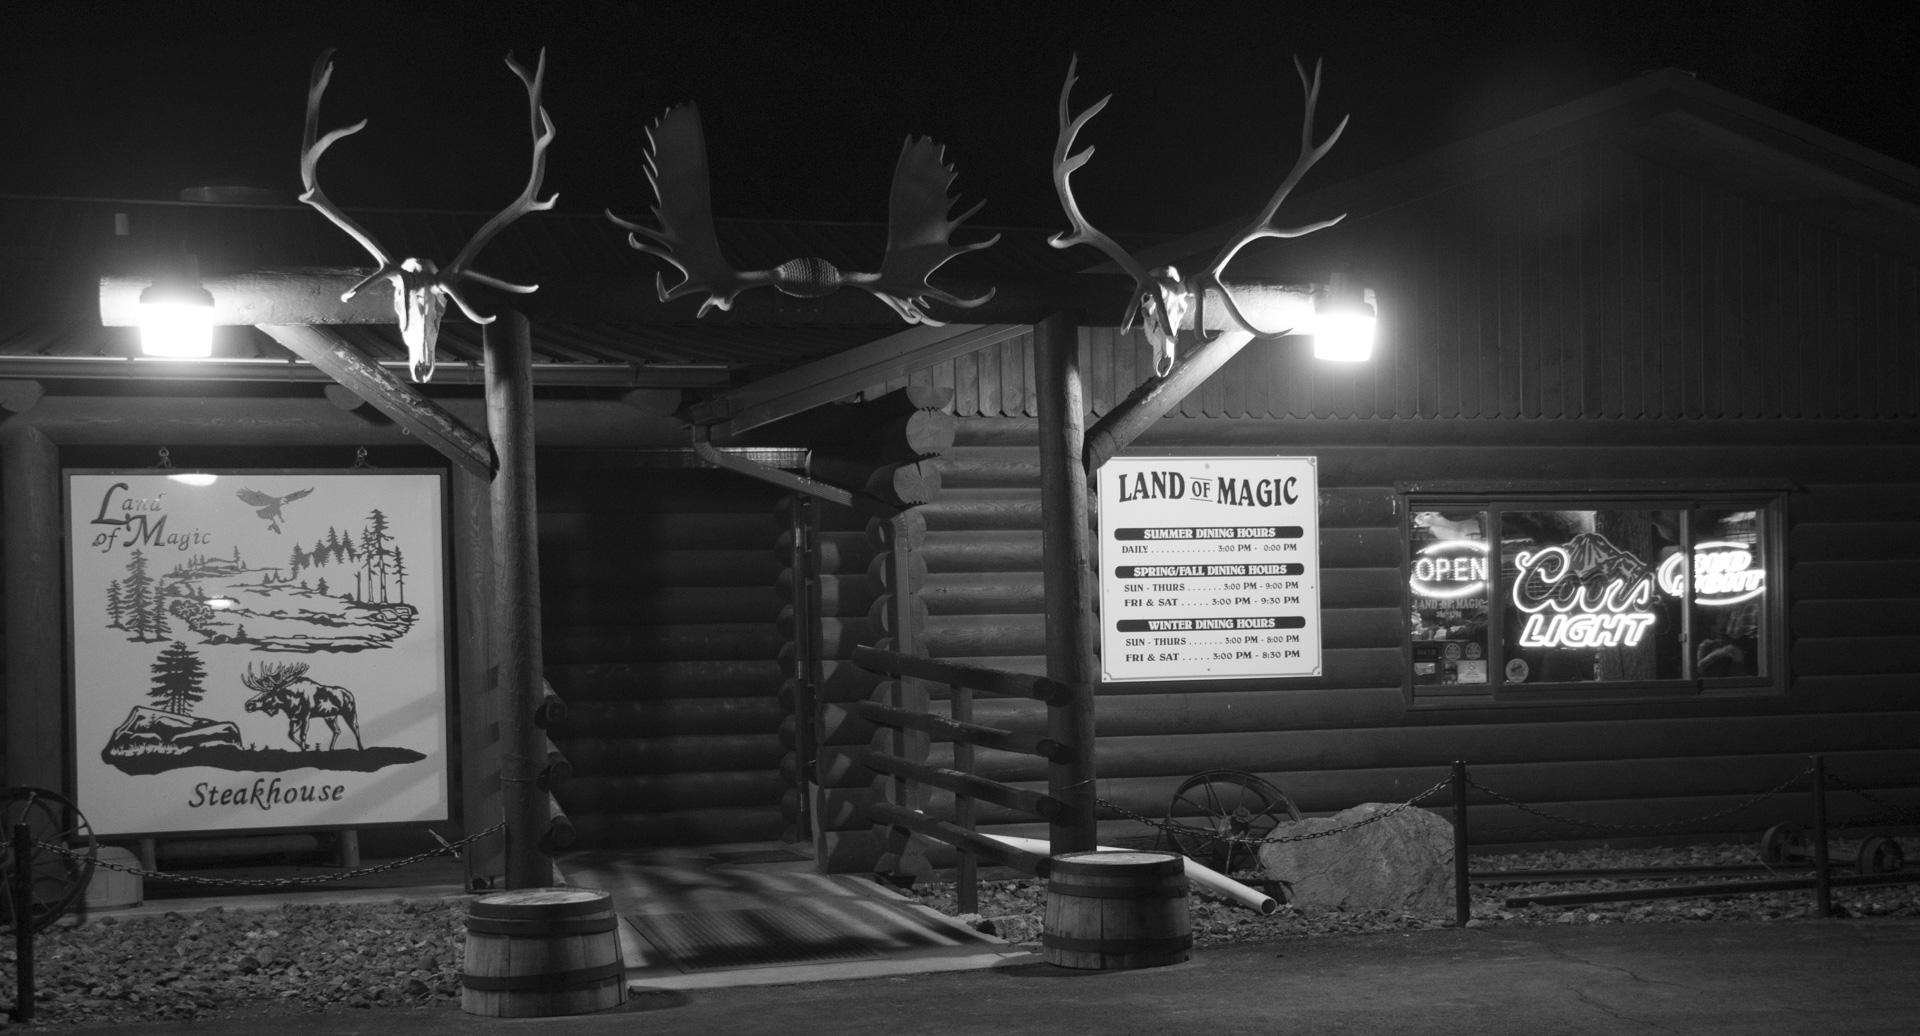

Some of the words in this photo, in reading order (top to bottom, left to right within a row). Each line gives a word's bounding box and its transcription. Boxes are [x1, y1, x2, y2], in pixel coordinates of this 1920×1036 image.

[90, 483, 166, 525] Land
[1119, 472, 1185, 502] LAND
[1192, 481, 1210, 497] OF
[1217, 477, 1298, 507] MAGIC
[92, 527, 121, 553] of
[123, 513, 211, 551] Magic
[1144, 530, 1193, 539] SUMMER
[1196, 529, 1234, 538] DINING
[1237, 528, 1276, 538] HOURS
[1134, 566, 1204, 577] SPRING/FALL
[1207, 566, 1245, 575] DINING
[1248, 565, 1286, 574] HOURS
[1416, 557, 1486, 581] OPEN
[1513, 547, 1656, 612] Coors
[1148, 621, 1192, 630] WINTER
[1195, 619, 1233, 629] DINING
[1237, 619, 1275, 628] HOURS
[1519, 614, 1656, 648] LIGHT
[189, 778, 345, 810] Steakhouse
